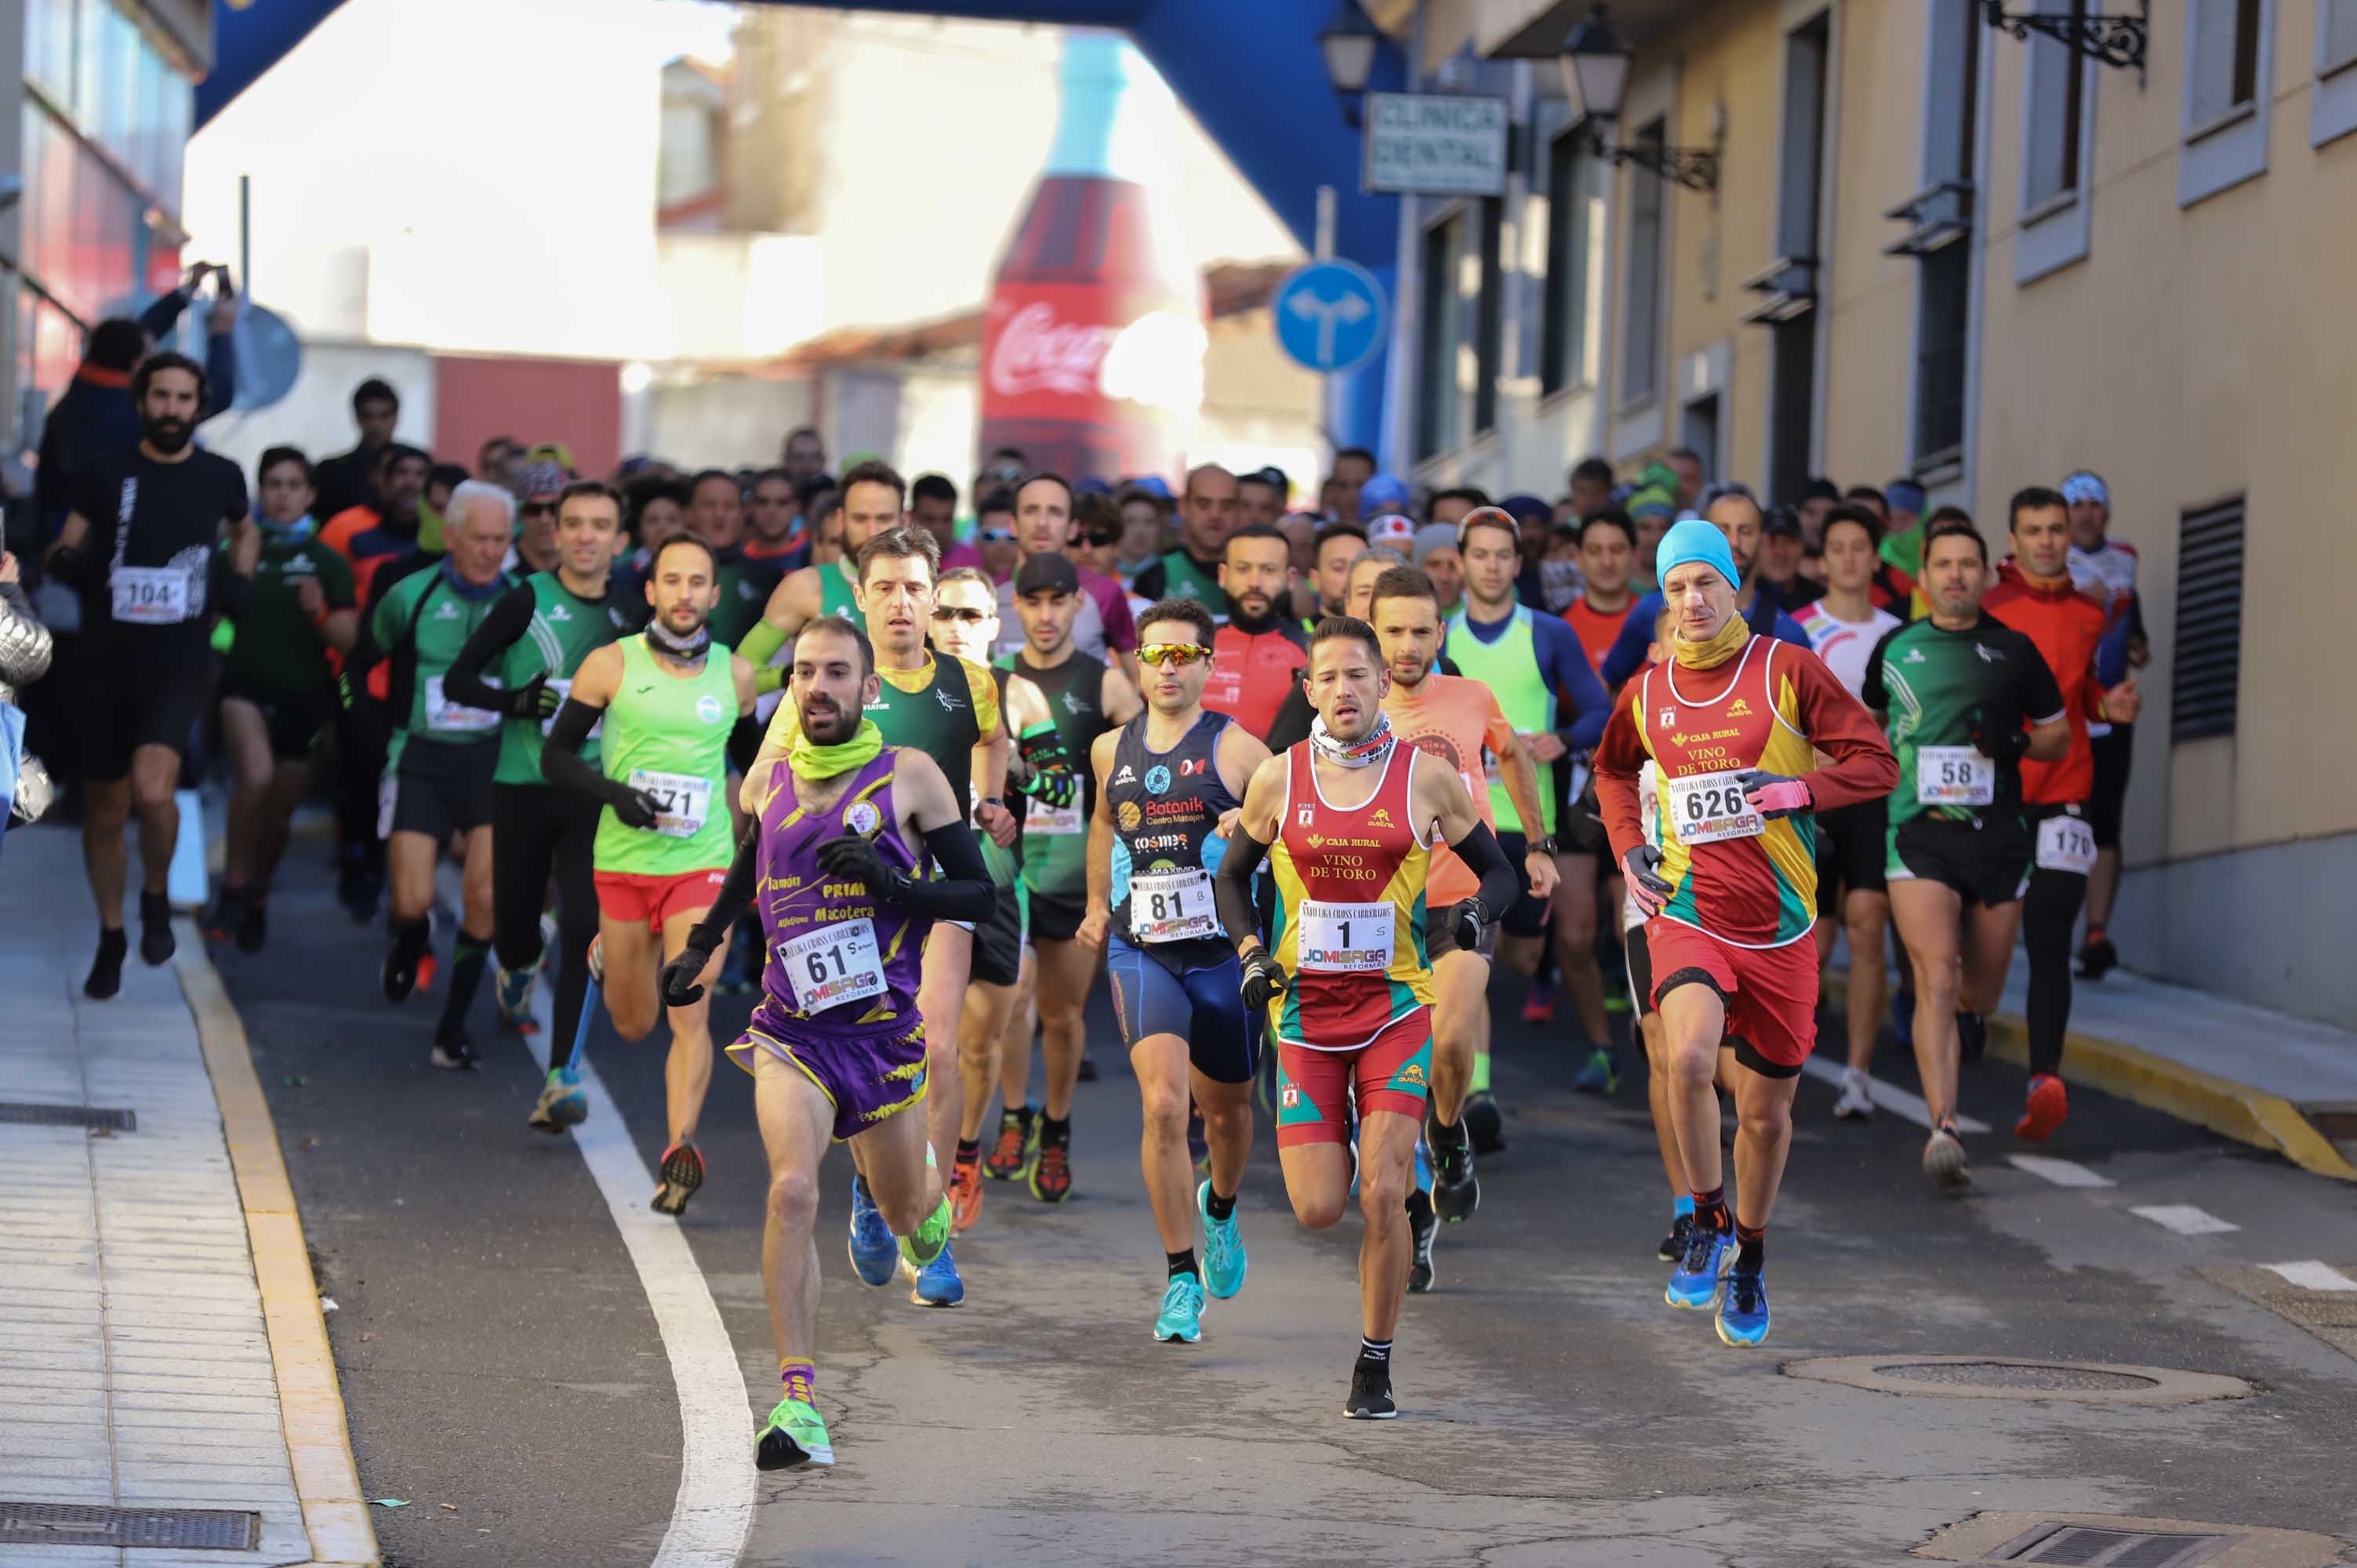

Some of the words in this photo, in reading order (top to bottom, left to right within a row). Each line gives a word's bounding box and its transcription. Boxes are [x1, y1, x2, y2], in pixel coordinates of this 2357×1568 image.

[129, 582, 169, 604] 104
[1690, 733, 1711, 742] CAJA
[1712, 728, 1741, 739] RURAL
[1687, 746, 1726, 760] VINO
[1677, 763, 1697, 776] DE
[1698, 757, 1741, 772] TORO
[1942, 762, 1972, 784] 58
[1146, 797, 1204, 816] Botanik
[1687, 787, 1742, 820] 626
[1146, 817, 1172, 826] Centro
[1173, 814, 1205, 824] Masajes
[1680, 814, 1758, 837] JOMISAGA
[1326, 837, 1349, 846] CAJA
[1351, 838, 1381, 848] RURAL
[2056, 829, 2091, 858] 170
[1323, 855, 1363, 866] VINO
[1310, 866, 1330, 878] DE
[1333, 867, 1377, 880] TORO
[823, 882, 866, 898] PRIM
[815, 905, 875, 922] Macotera
[1151, 891, 1183, 920] 81
[1318, 909, 1331, 919] LIGA
[1333, 909, 1353, 919] CROSS
[1353, 908, 1391, 919] CABRERIZOS
[1338, 921, 1350, 949] 1
[806, 945, 846, 984] 61
[1304, 949, 1386, 964] JOMISAGA
[835, 986, 879, 1003] REFORMAS
